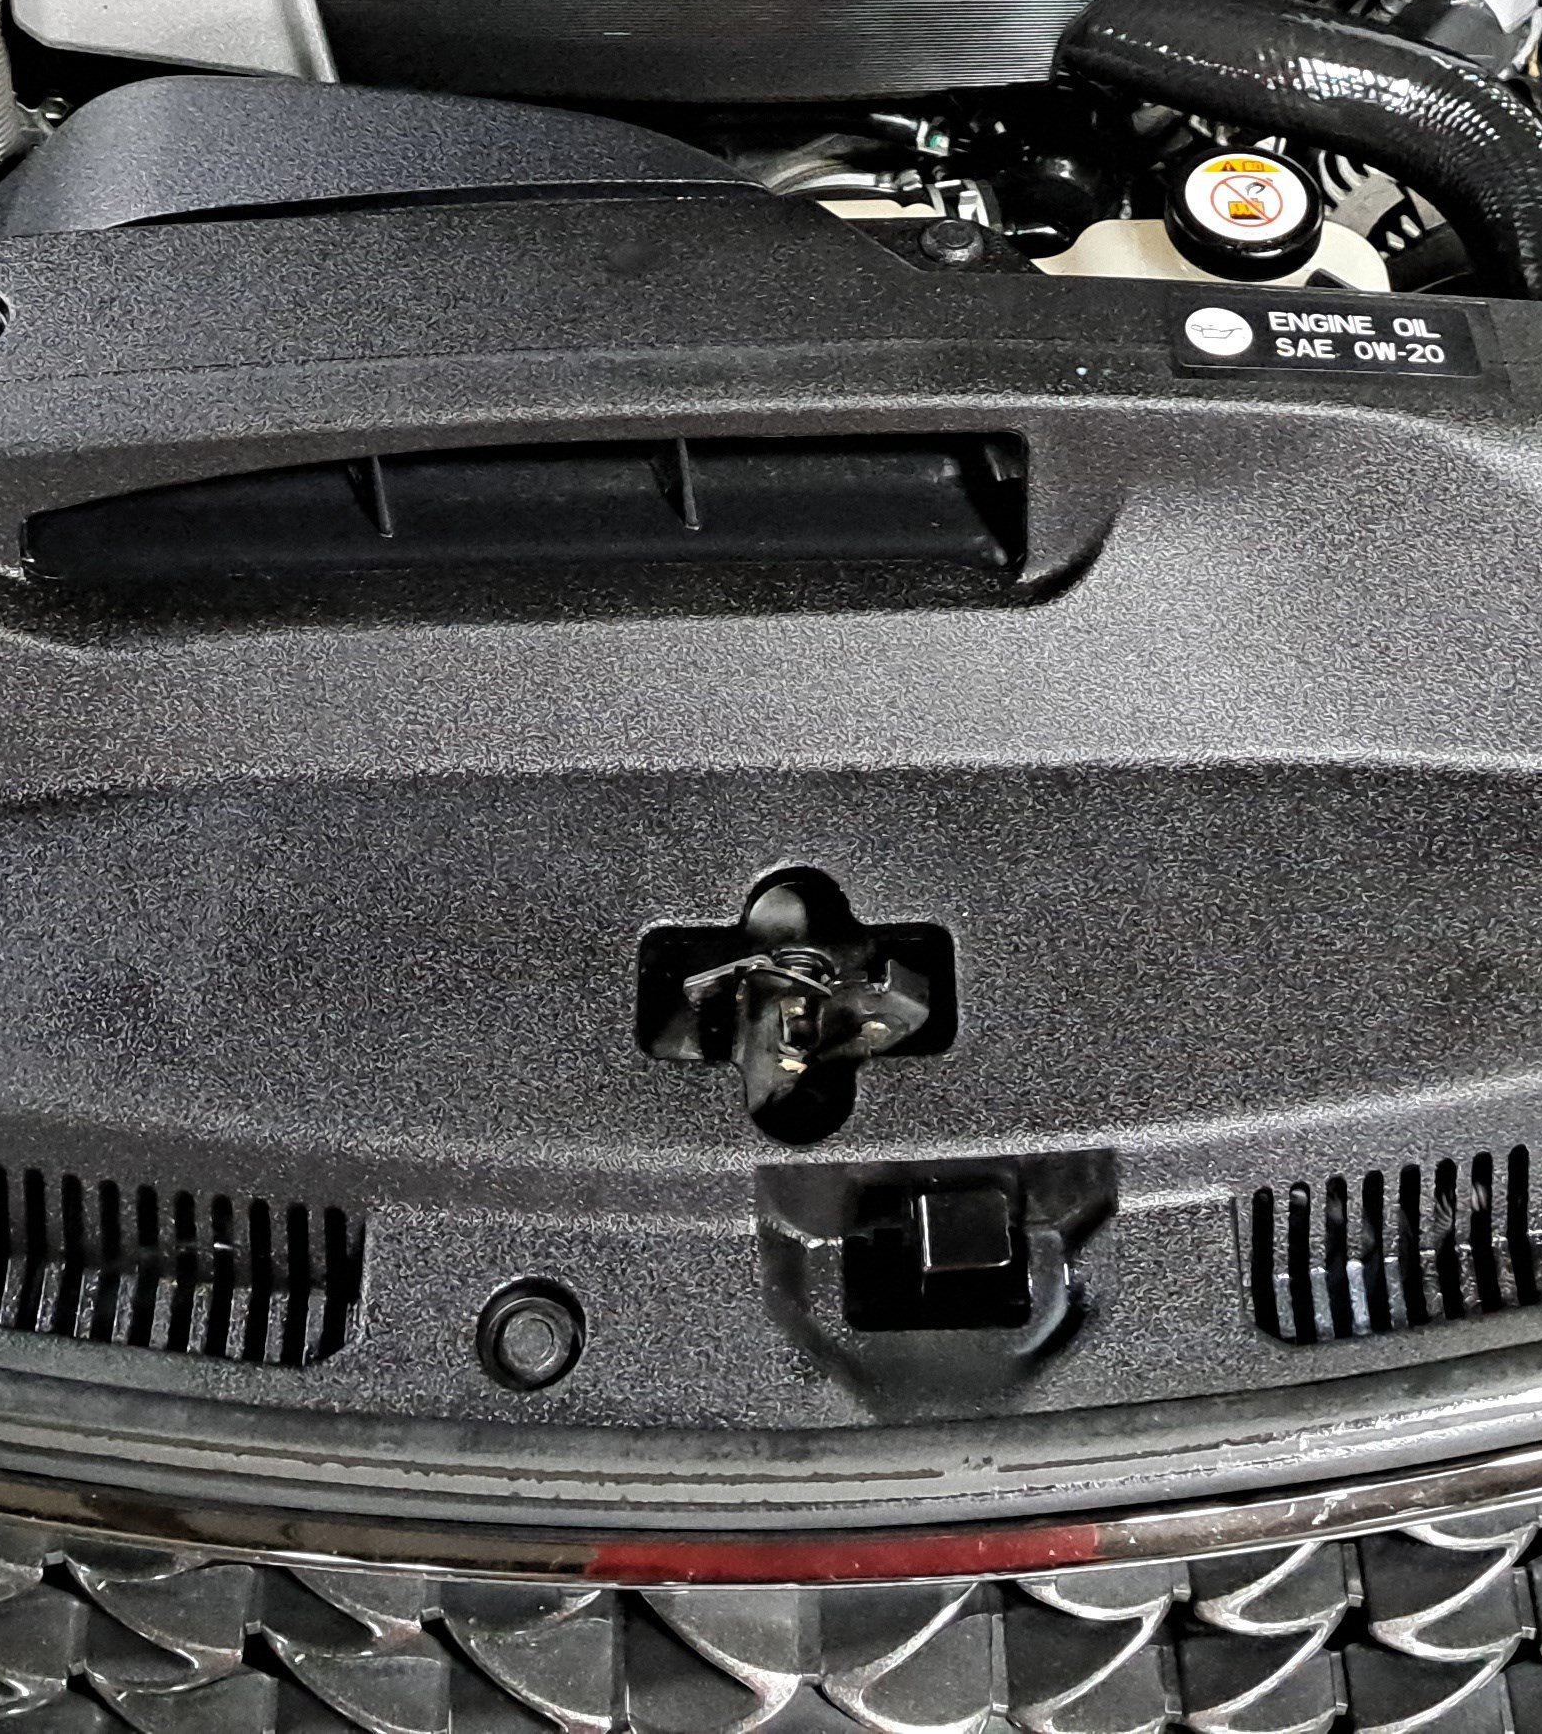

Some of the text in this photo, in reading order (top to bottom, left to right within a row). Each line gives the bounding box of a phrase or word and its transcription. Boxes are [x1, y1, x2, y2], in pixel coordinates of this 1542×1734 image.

[1268, 311, 1441, 339] ENGINE OIL
[1276, 338, 1445, 364] SAE 0W-20
